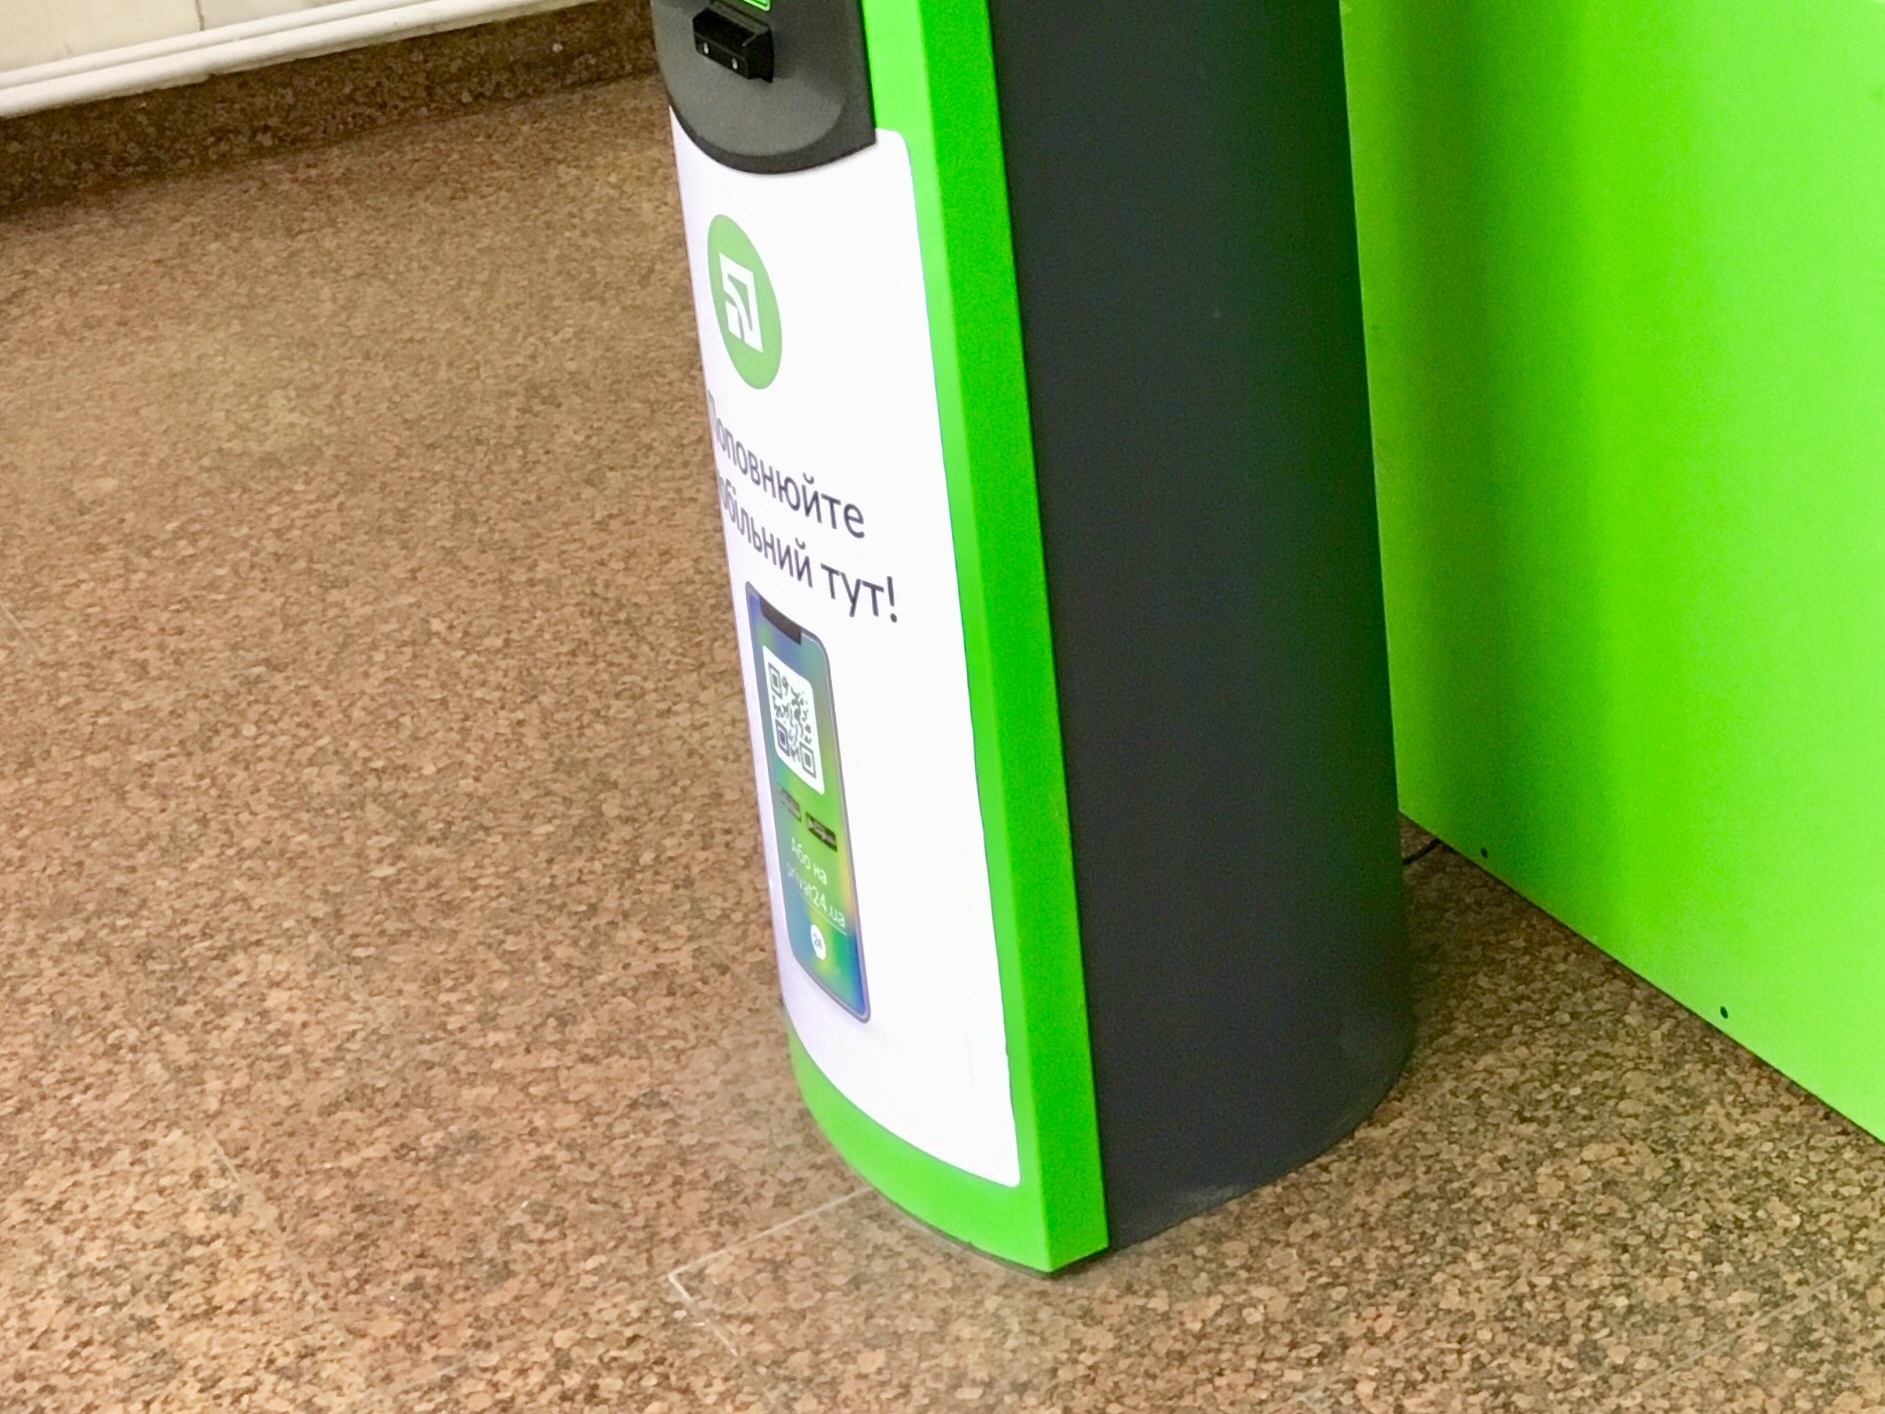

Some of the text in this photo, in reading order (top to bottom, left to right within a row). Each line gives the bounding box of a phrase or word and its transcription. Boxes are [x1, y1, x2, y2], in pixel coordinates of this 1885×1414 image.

[820, 563, 898, 623] тут!
[791, 837, 811, 870] Або
[812, 863, 827, 885] на
